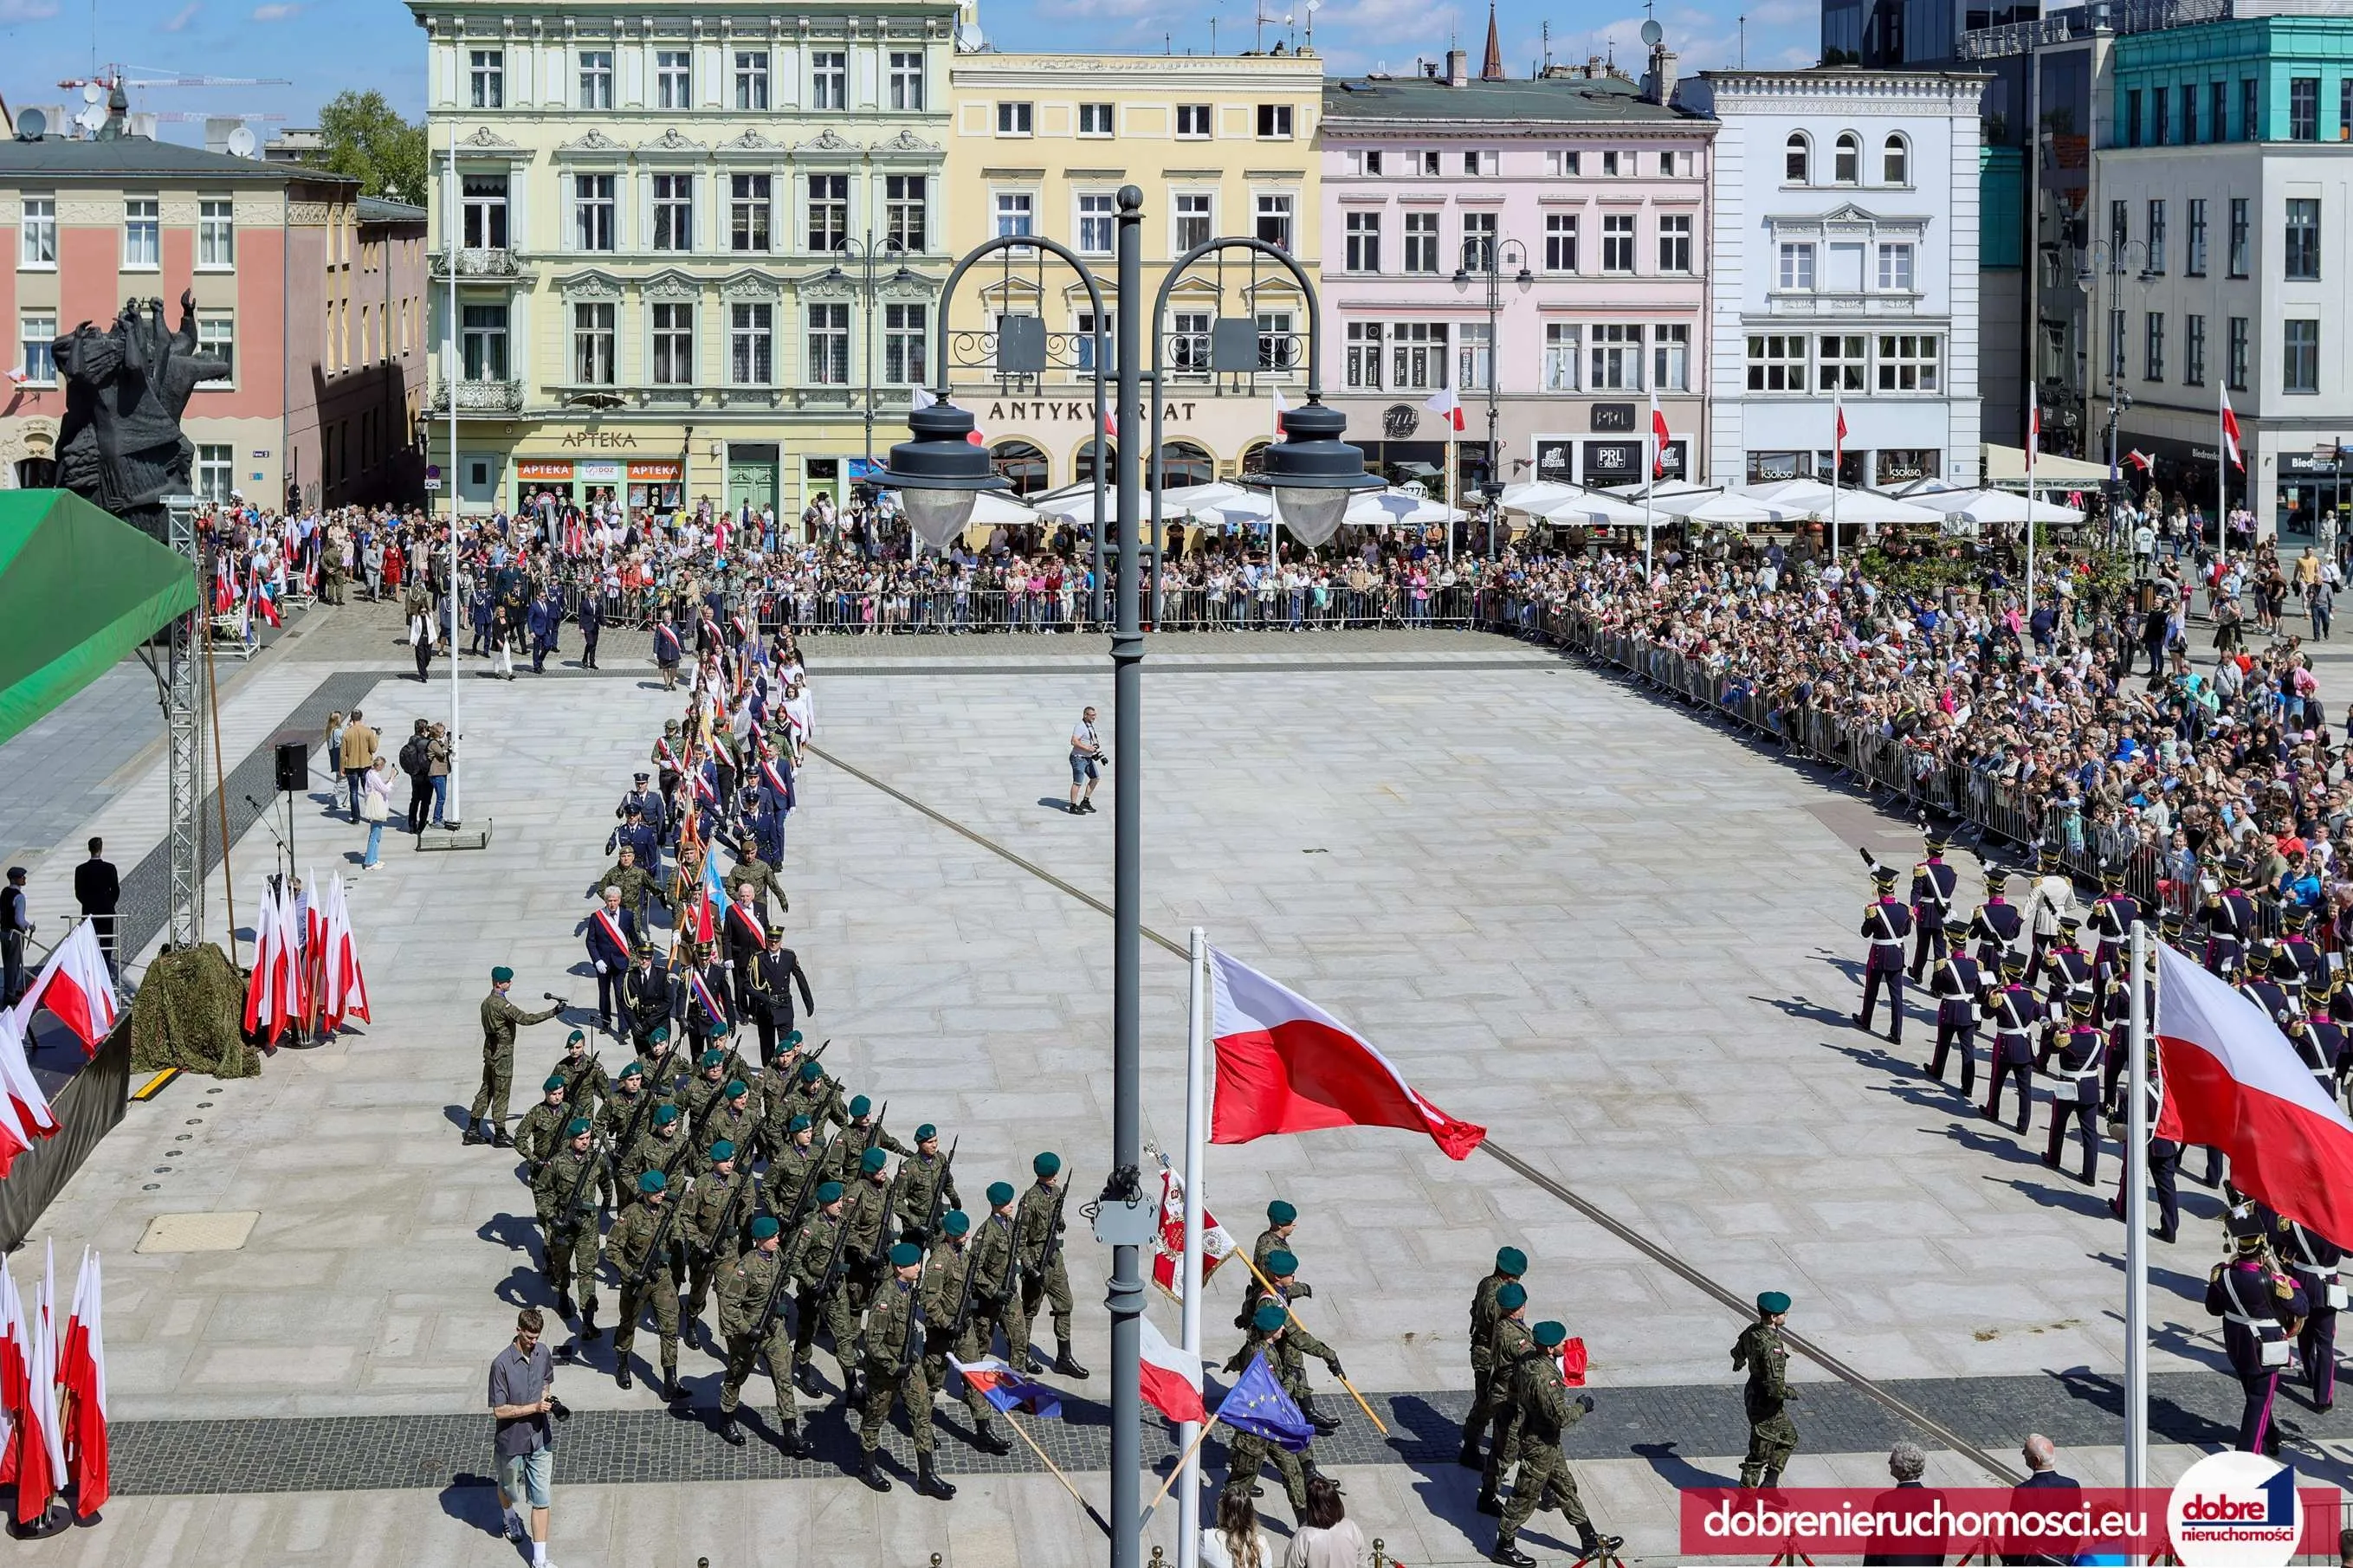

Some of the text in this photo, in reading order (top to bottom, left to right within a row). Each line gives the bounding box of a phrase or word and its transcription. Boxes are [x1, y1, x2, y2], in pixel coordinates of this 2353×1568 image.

[561, 431, 637, 448] APTEKA
[1600, 449, 1624, 461] PRL
[522, 464, 569, 474] APTEKA
[631, 464, 678, 474] APTEKA
[1542, 458, 1564, 468] Kozel
[1761, 465, 1794, 479] ksokso
[1889, 463, 1921, 477] ksokso
